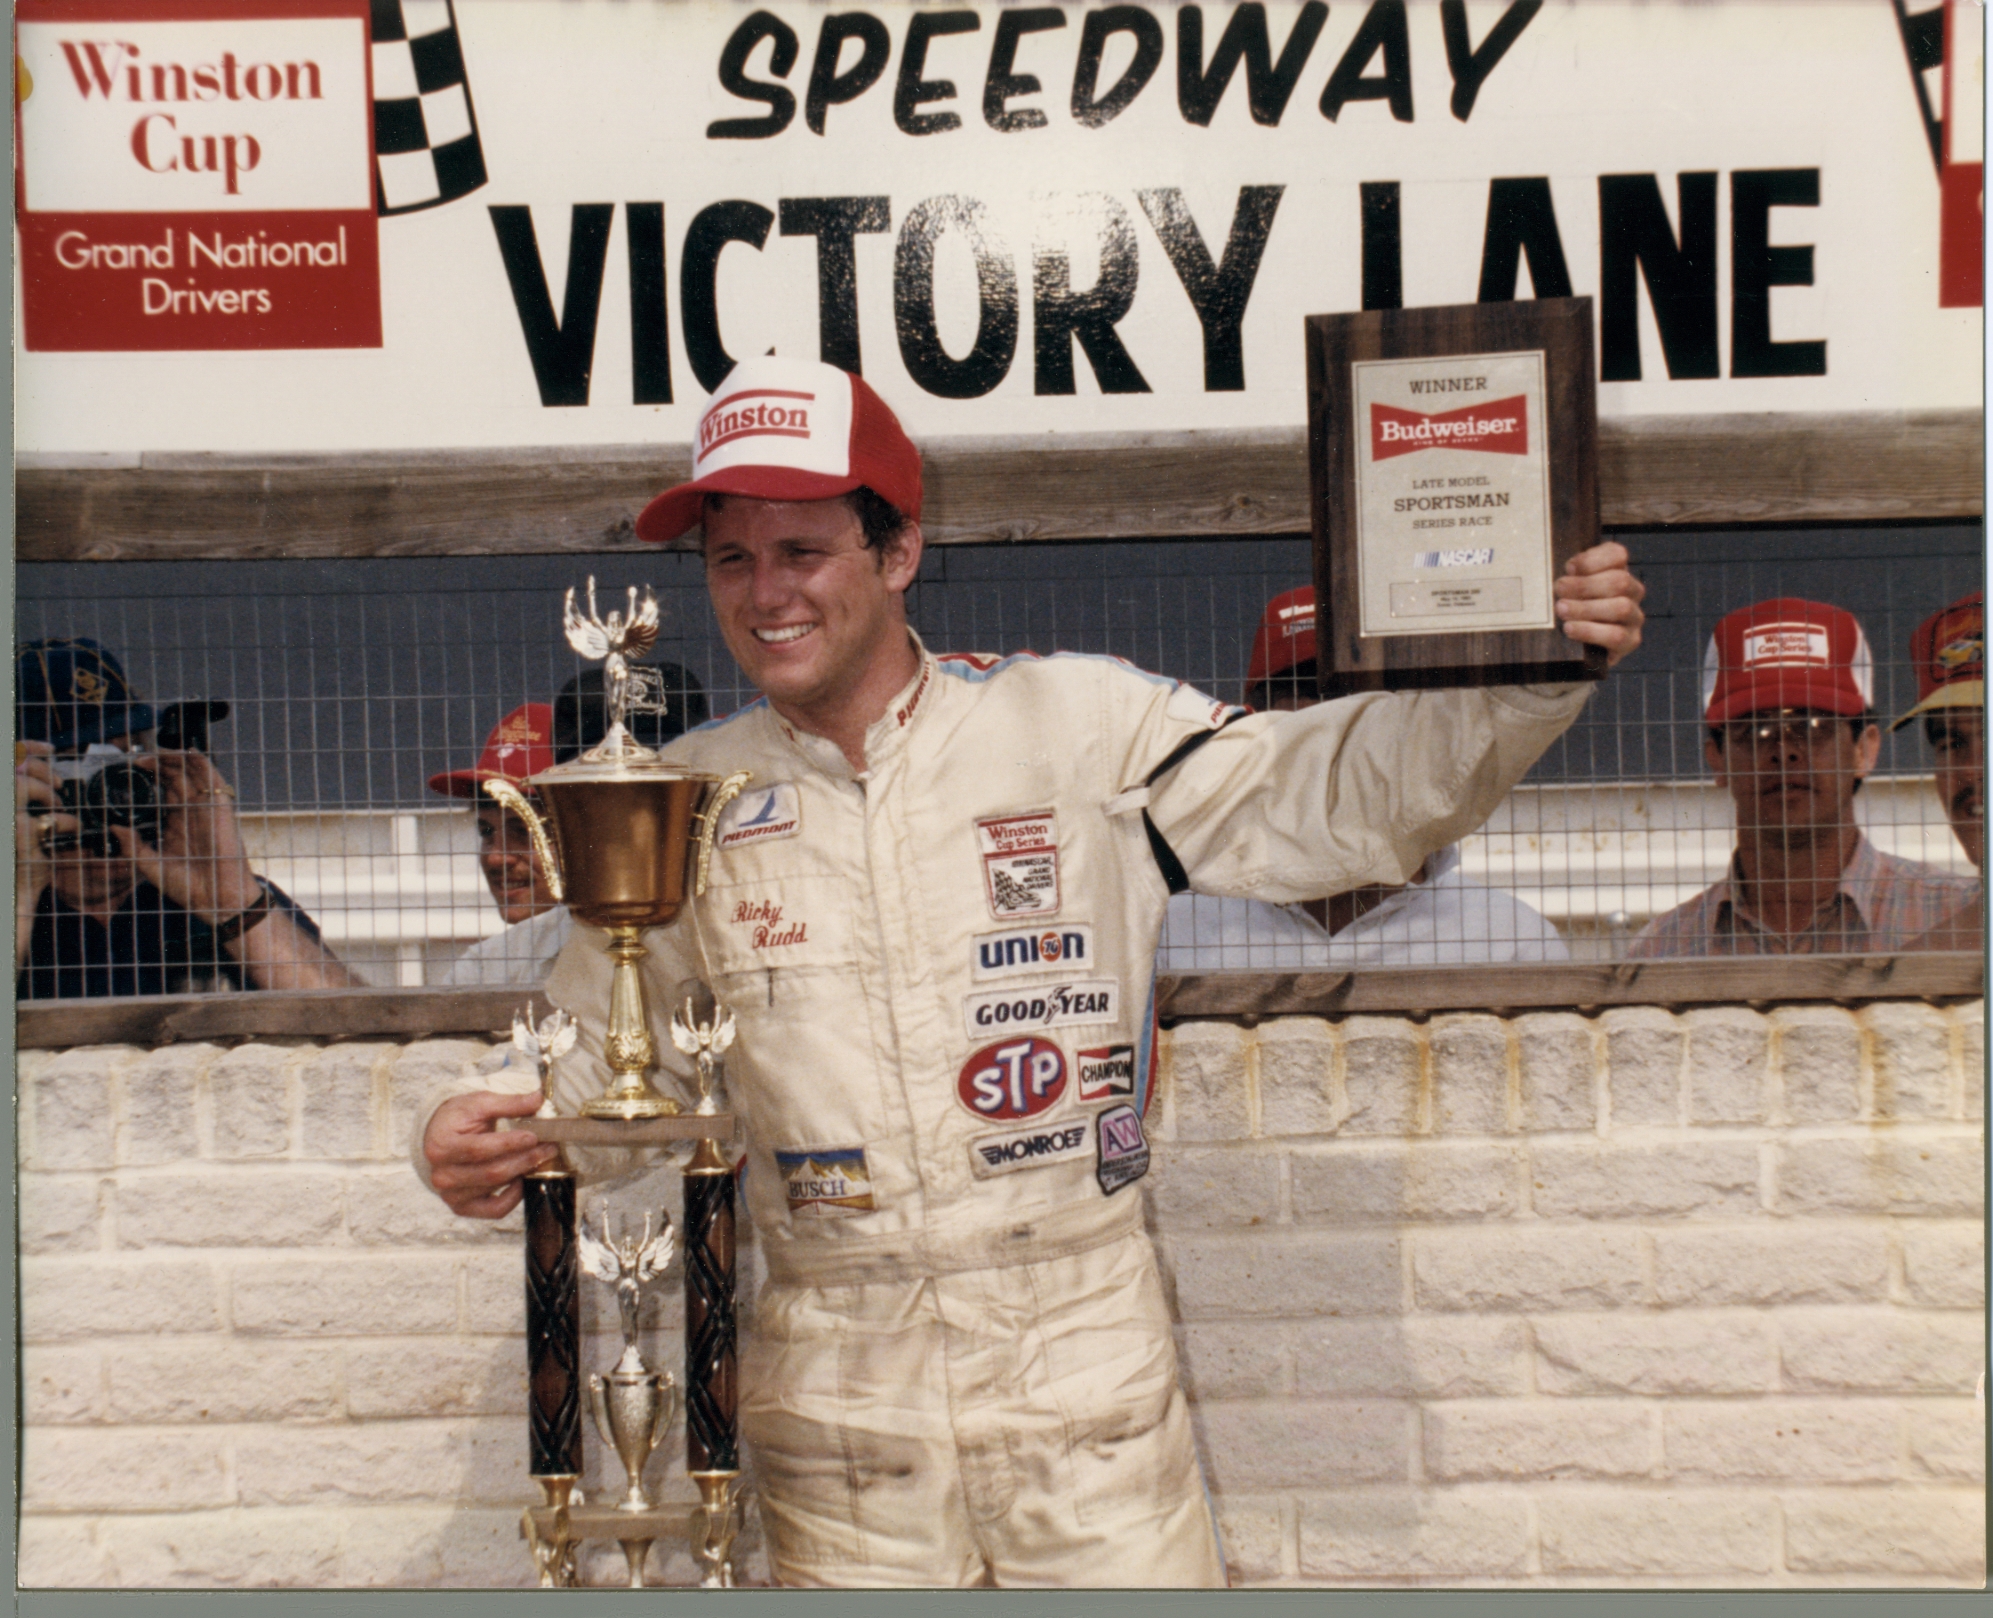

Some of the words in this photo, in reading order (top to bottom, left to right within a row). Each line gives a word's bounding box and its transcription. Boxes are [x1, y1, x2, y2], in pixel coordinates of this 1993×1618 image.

[58, 40, 325, 102] Winston
[706, 0, 1545, 139] SPEEDWAY
[130, 113, 261, 195] Cup
[55, 229, 174, 270] Grand
[189, 226, 347, 268] National
[142, 277, 272, 315] Drivers
[487, 184, 1287, 407] VICTORY
[1409, 377, 1488, 394] WINNER
[700, 402, 808, 450] Winston
[1380, 415, 1518, 442] Budweiser
[1412, 478, 1445, 490] LATE
[1448, 476, 1491, 488] MODEL
[1394, 492, 1510, 512] SPORTSMAN
[1412, 518, 1455, 530] SERIES
[1459, 516, 1493, 527] RACE
[1439, 549, 1492, 567] NASCAR
[722, 820, 797, 844] PIEDMONT
[986, 824, 1048, 840] Winston
[996, 840, 1014, 851] Cup
[1016, 837, 1046, 848] Series
[731, 899, 783, 928] Ricky
[752, 922, 808, 949] Rudd
[972, 1040, 1060, 1112] STP
[1081, 1060, 1133, 1084] CHAMPION
[1000, 1130, 1074, 1162] MONROE
[788, 1179, 847, 1198] BUSCH
